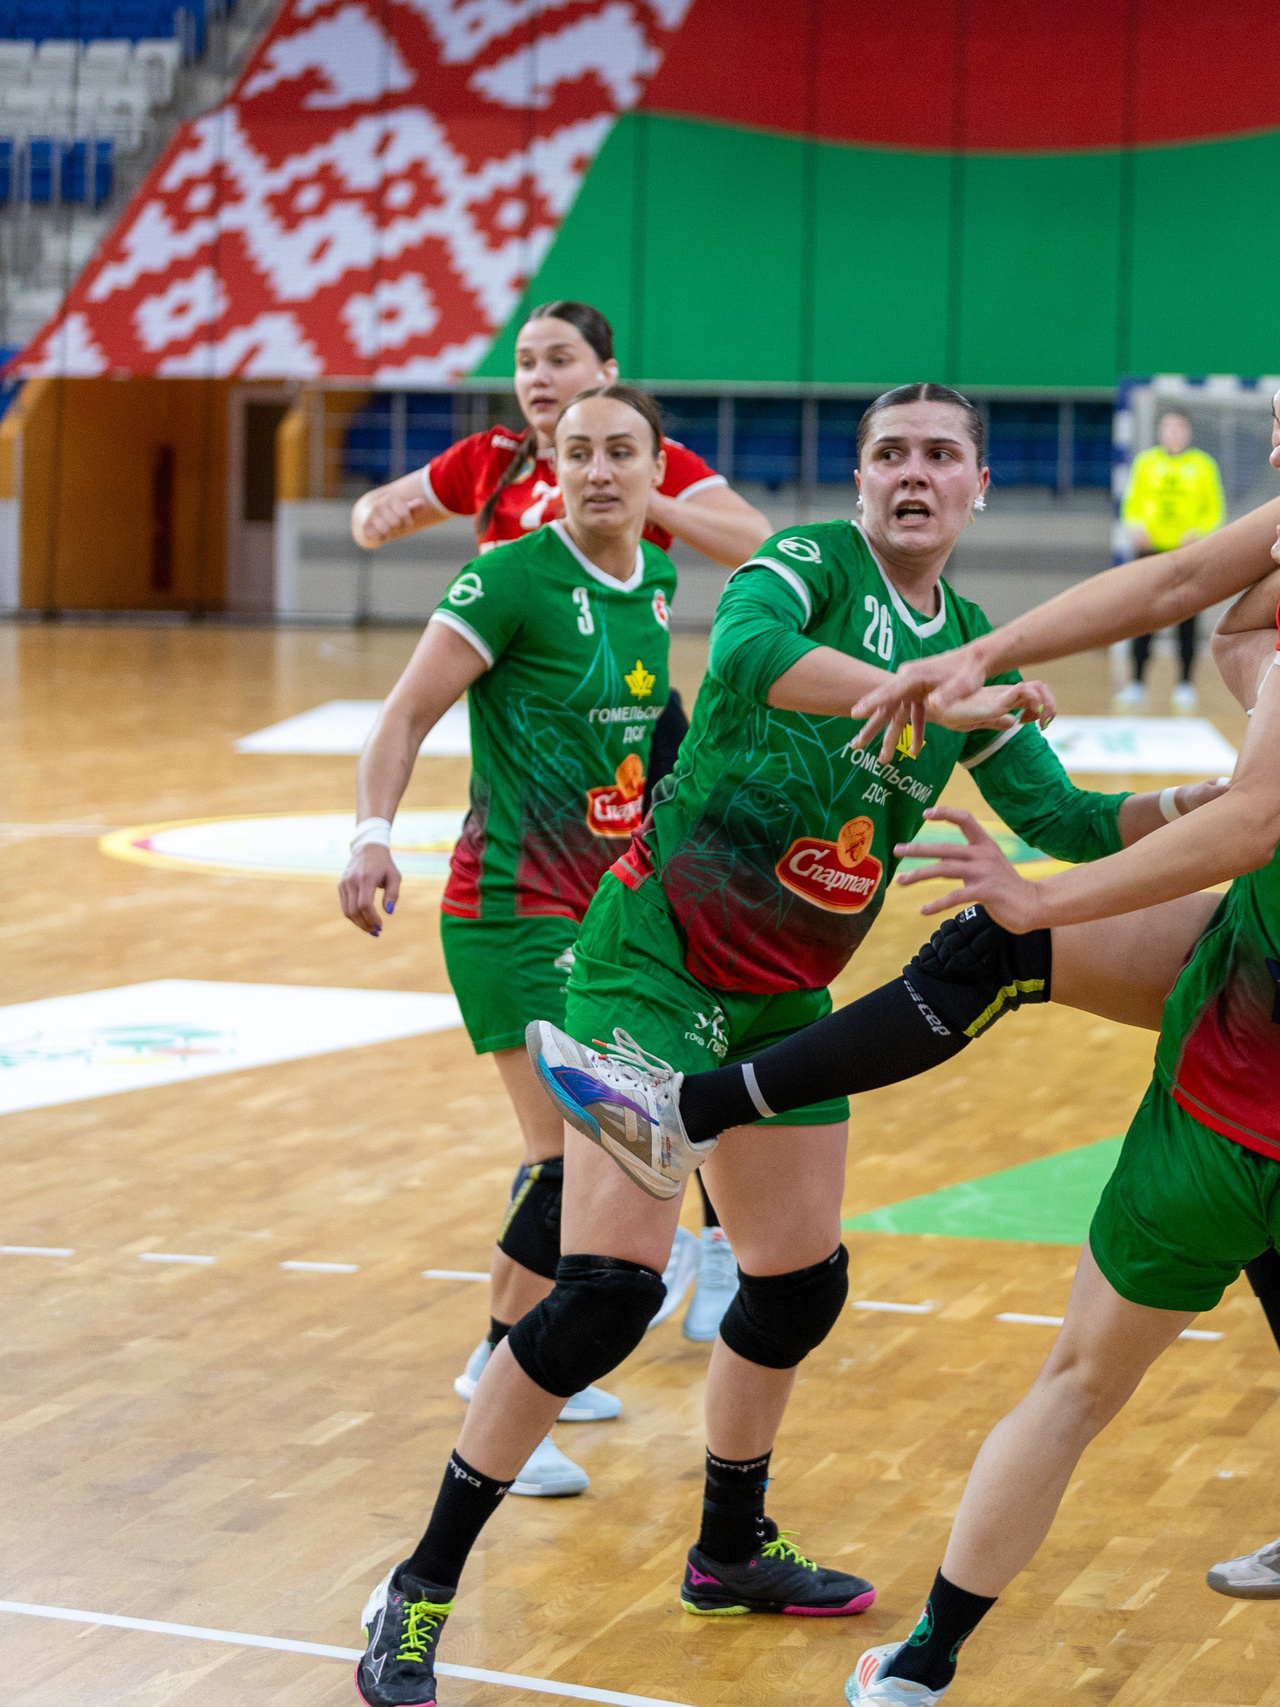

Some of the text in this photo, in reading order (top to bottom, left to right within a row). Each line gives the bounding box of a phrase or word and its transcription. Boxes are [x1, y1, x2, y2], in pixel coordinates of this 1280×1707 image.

[572, 586, 595, 636] 3
[862, 594, 893, 661] 26
[840, 741, 934, 804] ГОМЕЛЬСКИЙ
[861, 782, 893, 806] ДСК
[788, 848, 876, 896] Спартак
